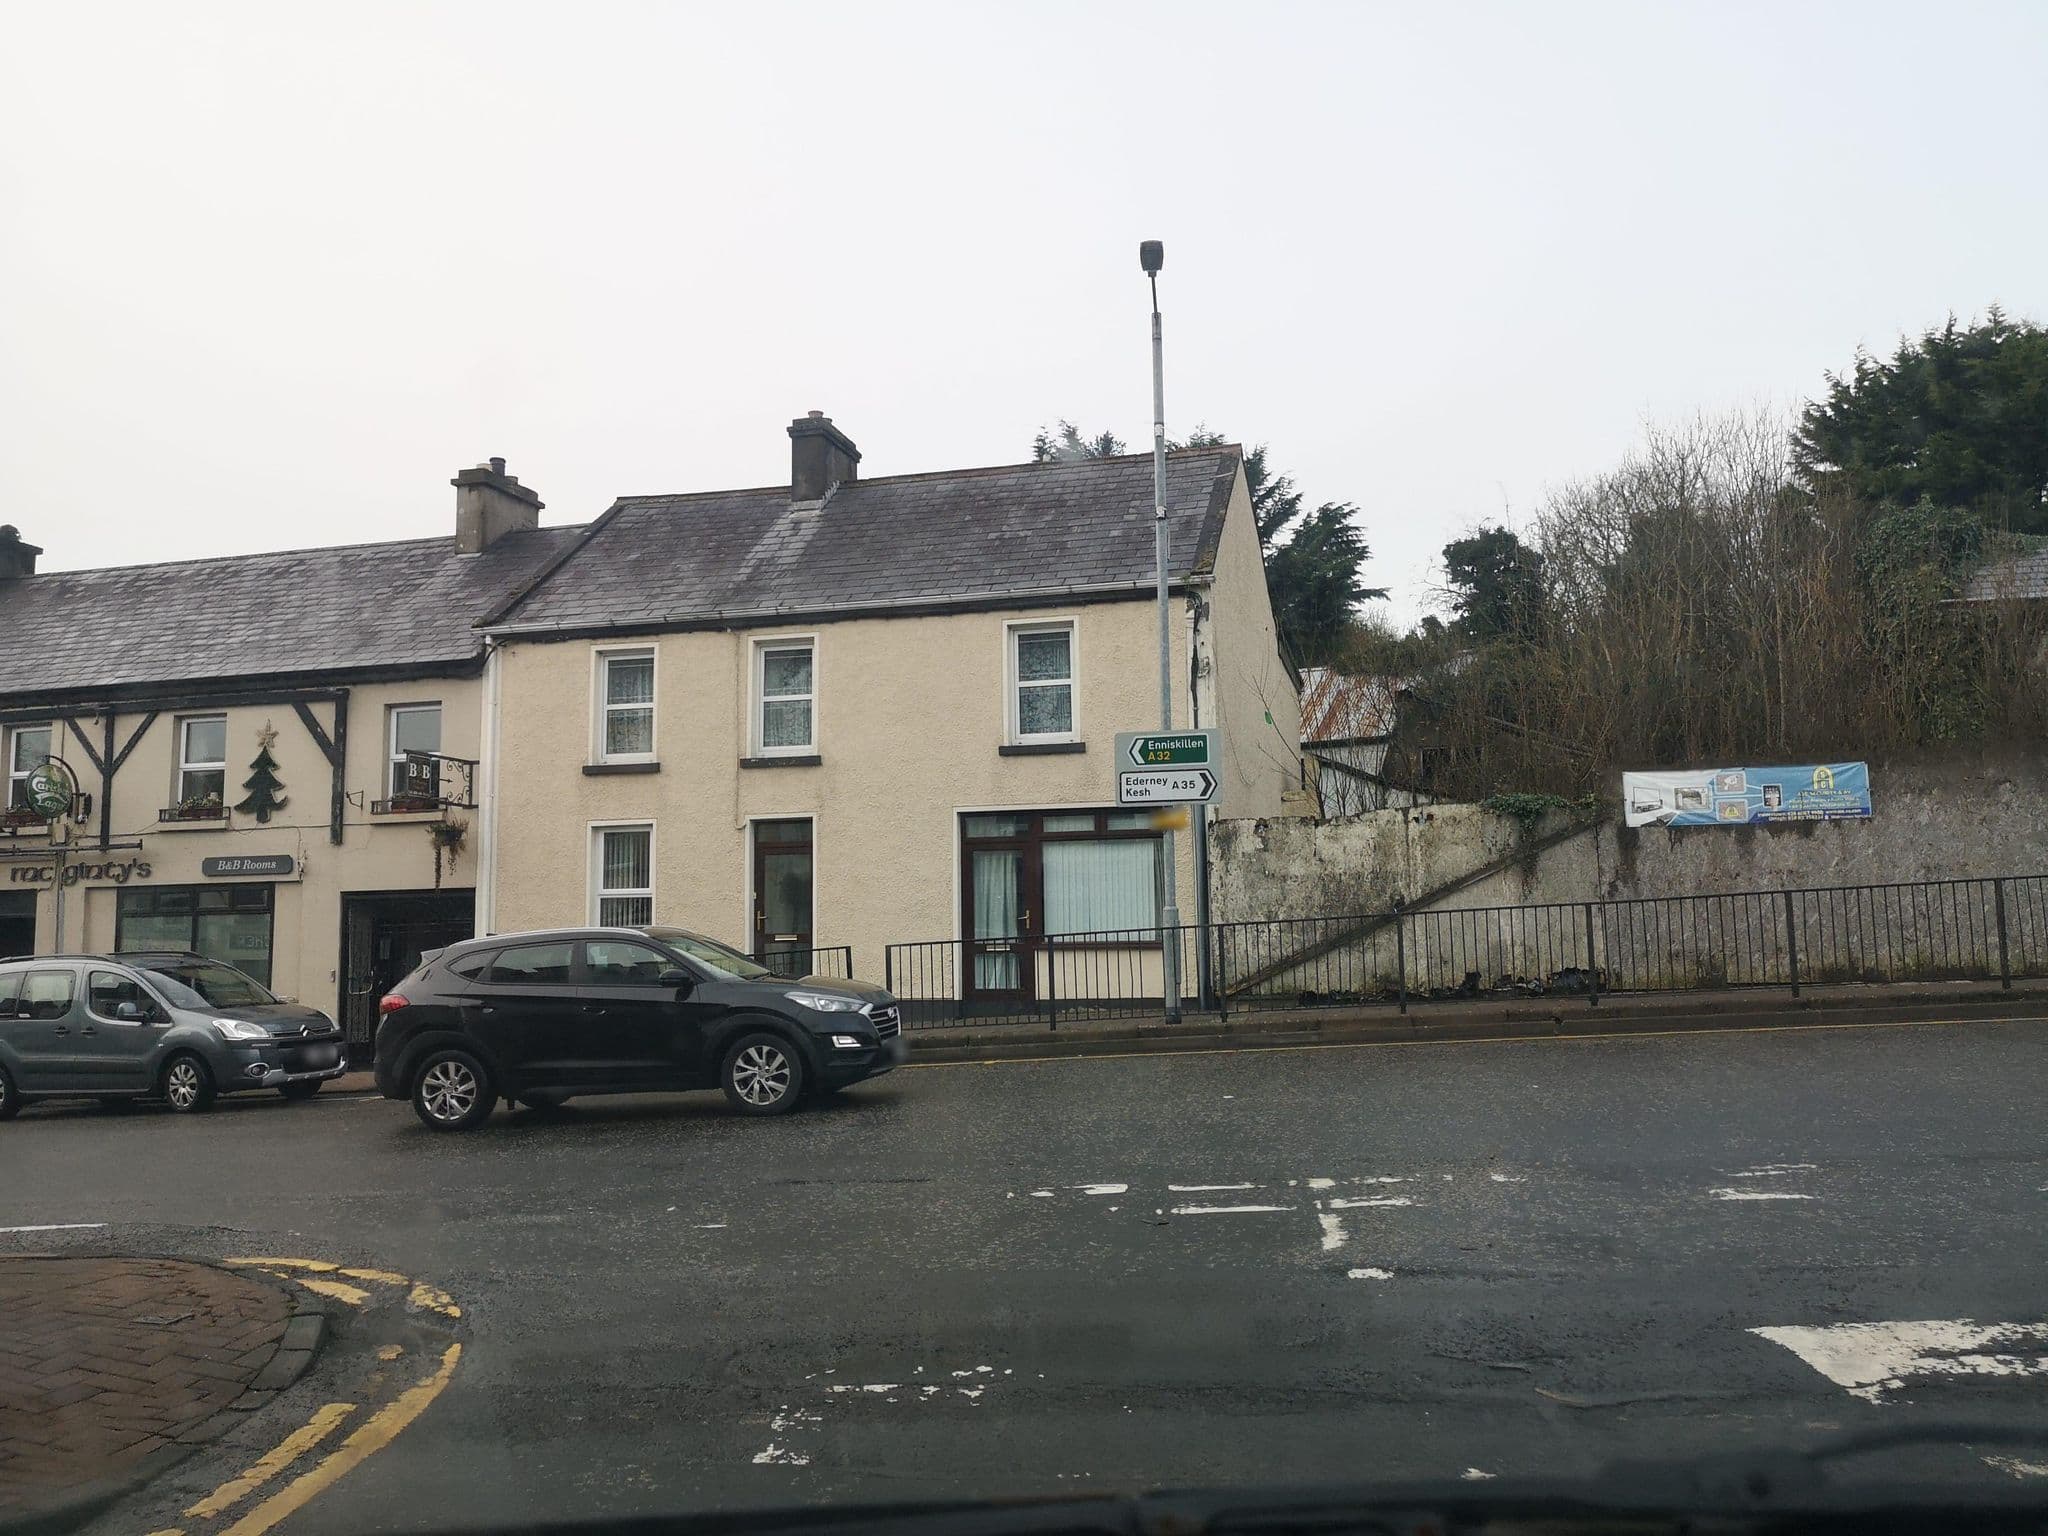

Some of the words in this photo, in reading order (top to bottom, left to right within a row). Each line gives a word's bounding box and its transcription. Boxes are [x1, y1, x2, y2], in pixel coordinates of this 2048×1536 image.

[1148, 738, 1204, 750] Enniskillen
[1148, 751, 1171, 761] A32
[1125, 777, 1168, 786] Ederney
[1171, 780, 1196, 790] A35
[1126, 787, 1151, 797] Kesh
[217, 860, 241, 871] B&B
[242, 859, 277, 870] Rooms
